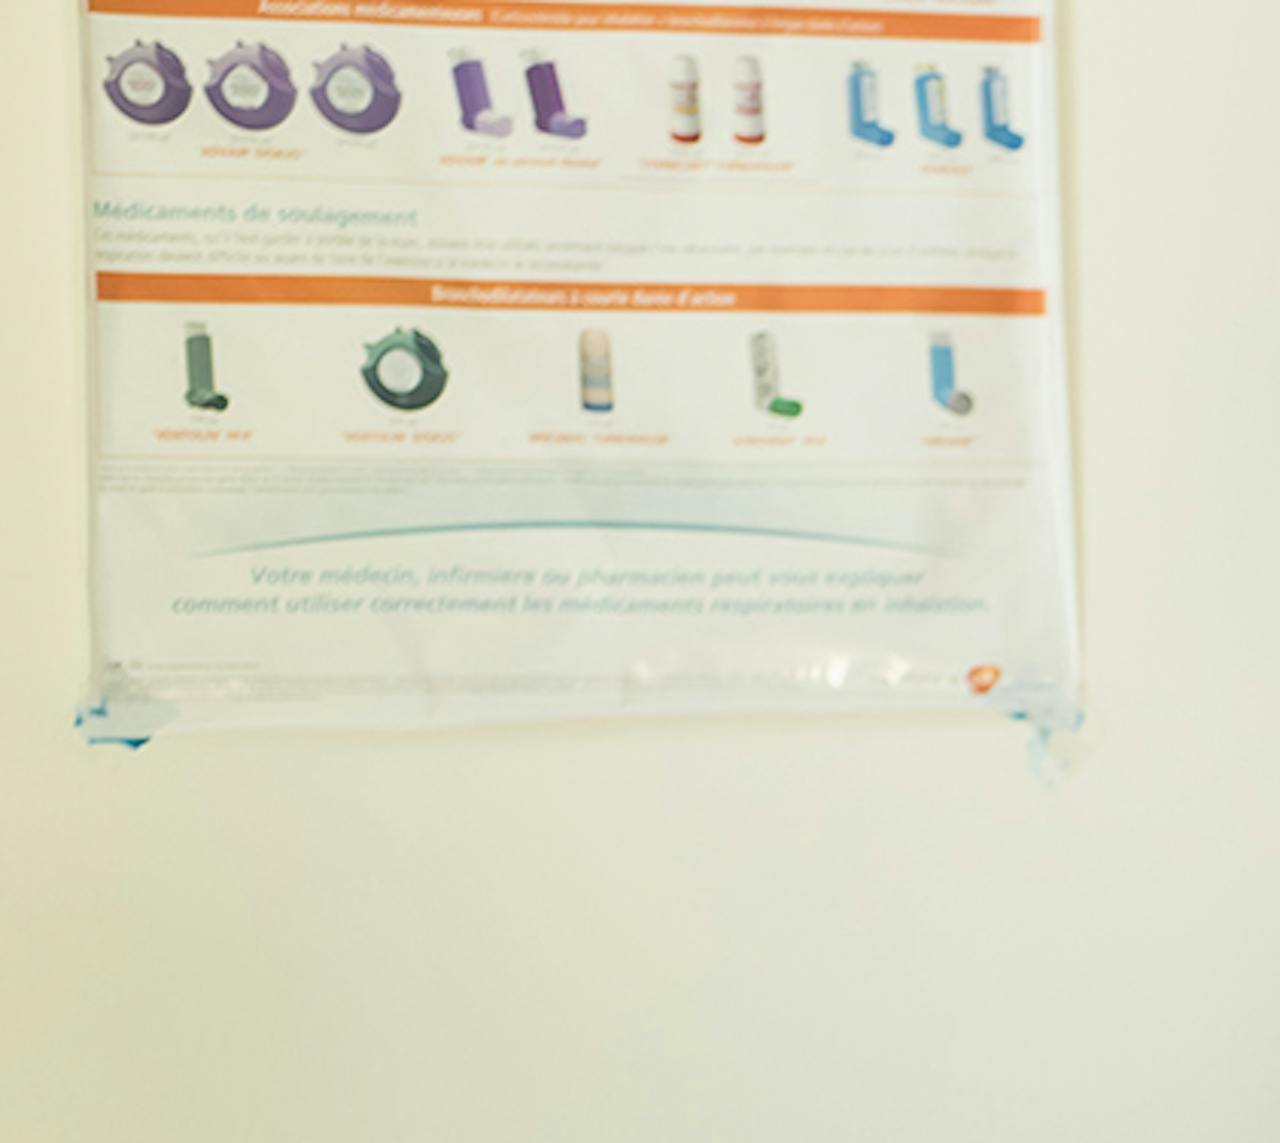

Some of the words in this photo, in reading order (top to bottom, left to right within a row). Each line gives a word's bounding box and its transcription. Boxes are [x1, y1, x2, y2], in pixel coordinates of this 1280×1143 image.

[93, 200, 236, 221] Médicaments
[243, 203, 270, 221] de
[278, 205, 417, 228] soulagement
[250, 566, 313, 585] Votre
[319, 564, 420, 588] médecin,
[429, 564, 536, 585] infirmière
[543, 571, 570, 585] ou
[574, 567, 707, 589] pharmacien
[709, 568, 762, 589] peut
[769, 571, 818, 585] vous
[824, 568, 926, 589] expliquer
[171, 595, 279, 614] comment
[285, 594, 363, 613] utiliser
[369, 594, 518, 614] correctement
[522, 594, 550, 613] les
[558, 594, 705, 614] médicaments
[710, 595, 844, 617] respiratoires
[851, 598, 876, 613] en
